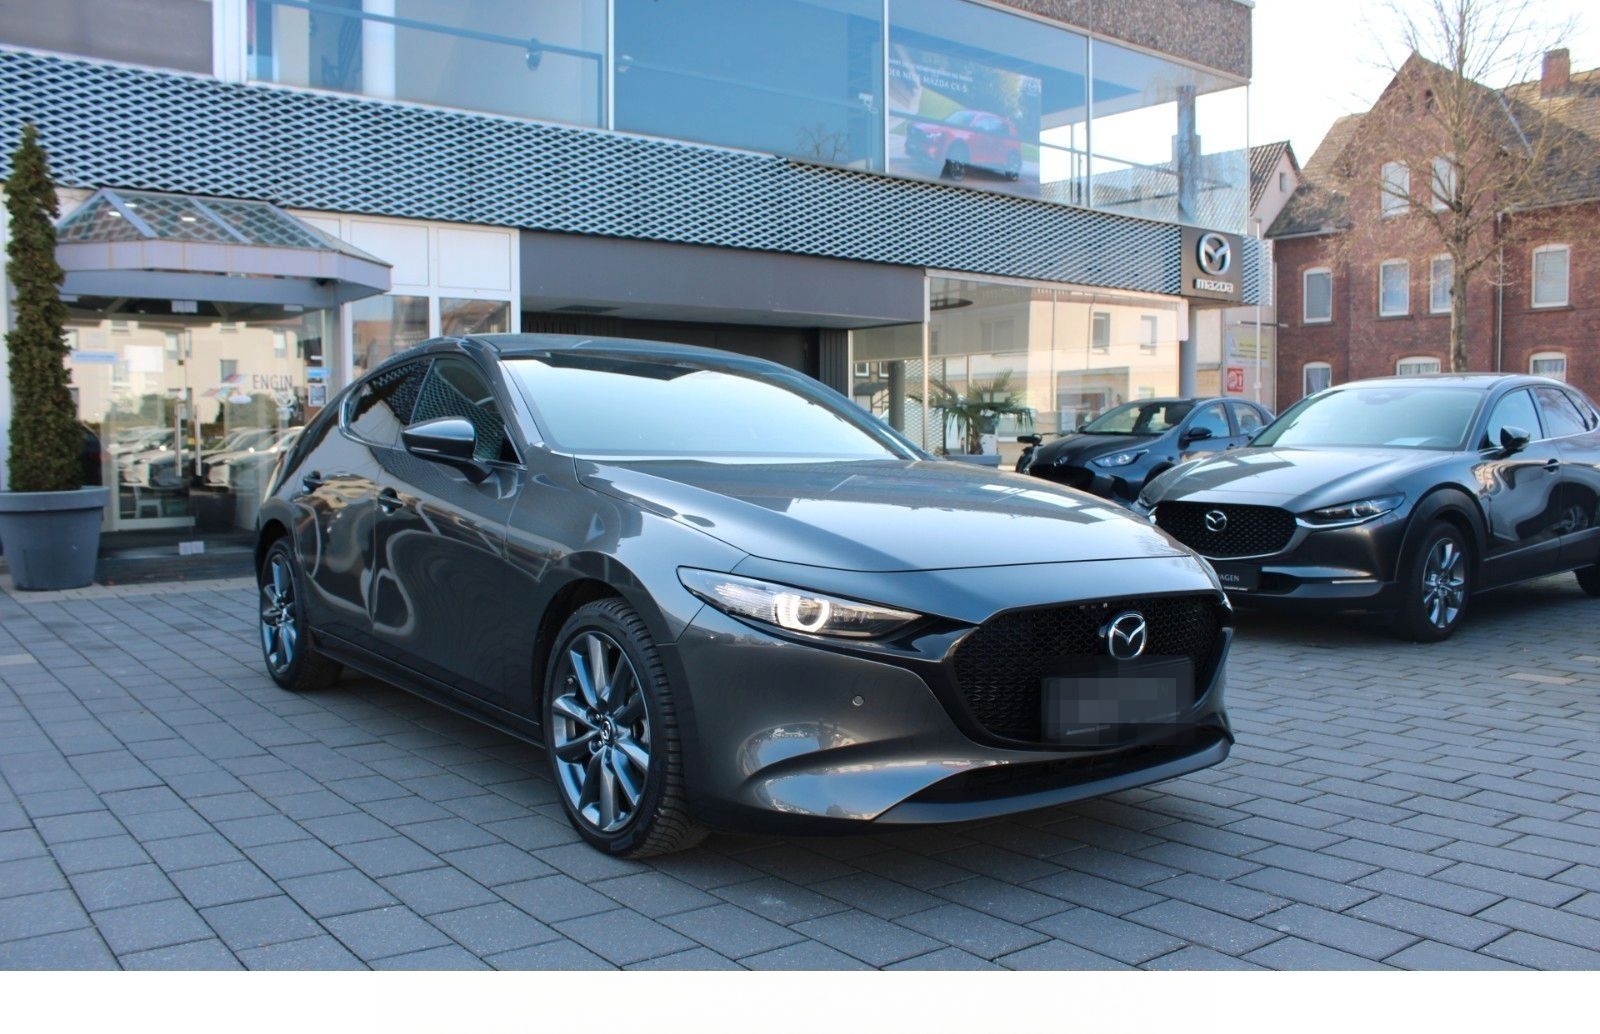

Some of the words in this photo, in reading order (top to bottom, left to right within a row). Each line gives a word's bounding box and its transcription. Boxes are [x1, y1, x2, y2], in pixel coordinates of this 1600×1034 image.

[923, 76, 949, 88] MAZDA
[1196, 278, 1233, 293] mazda
[253, 374, 292, 391] ENGIN
